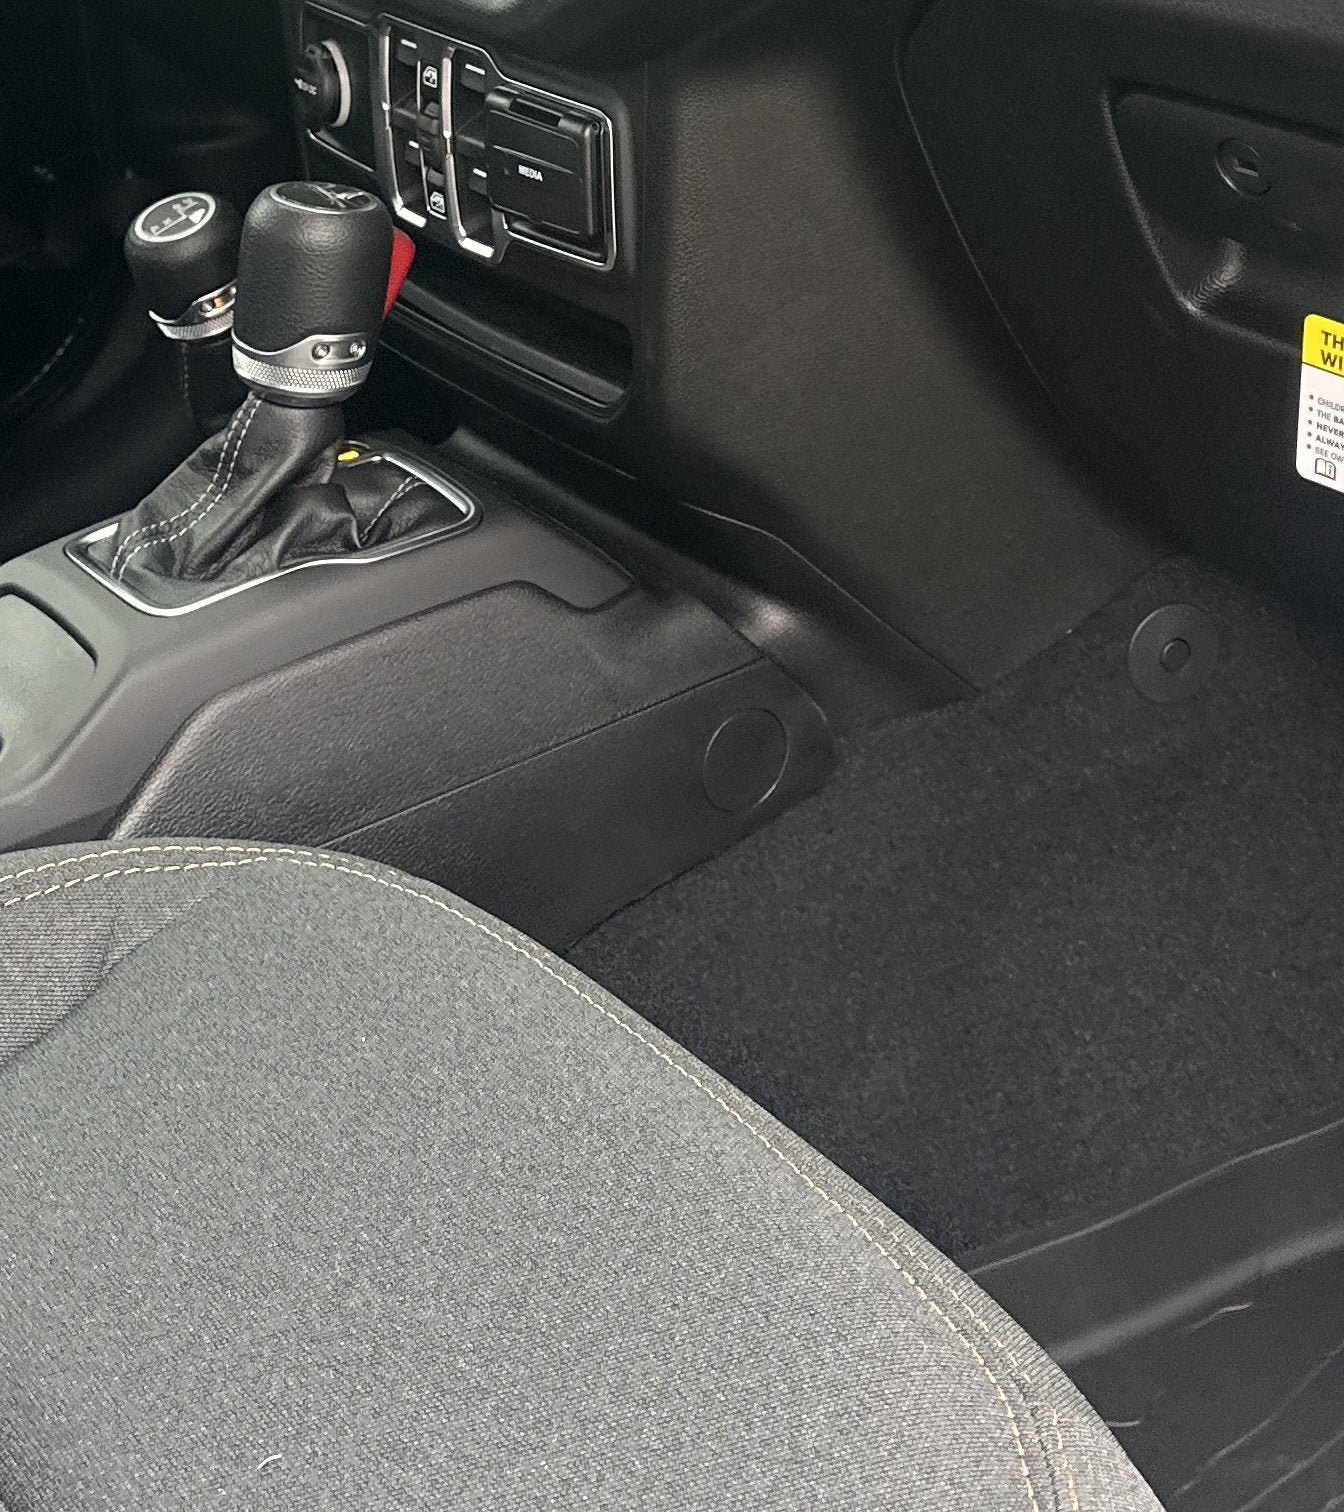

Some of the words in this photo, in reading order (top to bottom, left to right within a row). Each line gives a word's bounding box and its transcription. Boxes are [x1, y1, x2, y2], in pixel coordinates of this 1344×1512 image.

[1317, 407, 1331, 421] THE
[1316, 420, 1344, 439] NEVER
[1315, 445, 1329, 458] SEE
